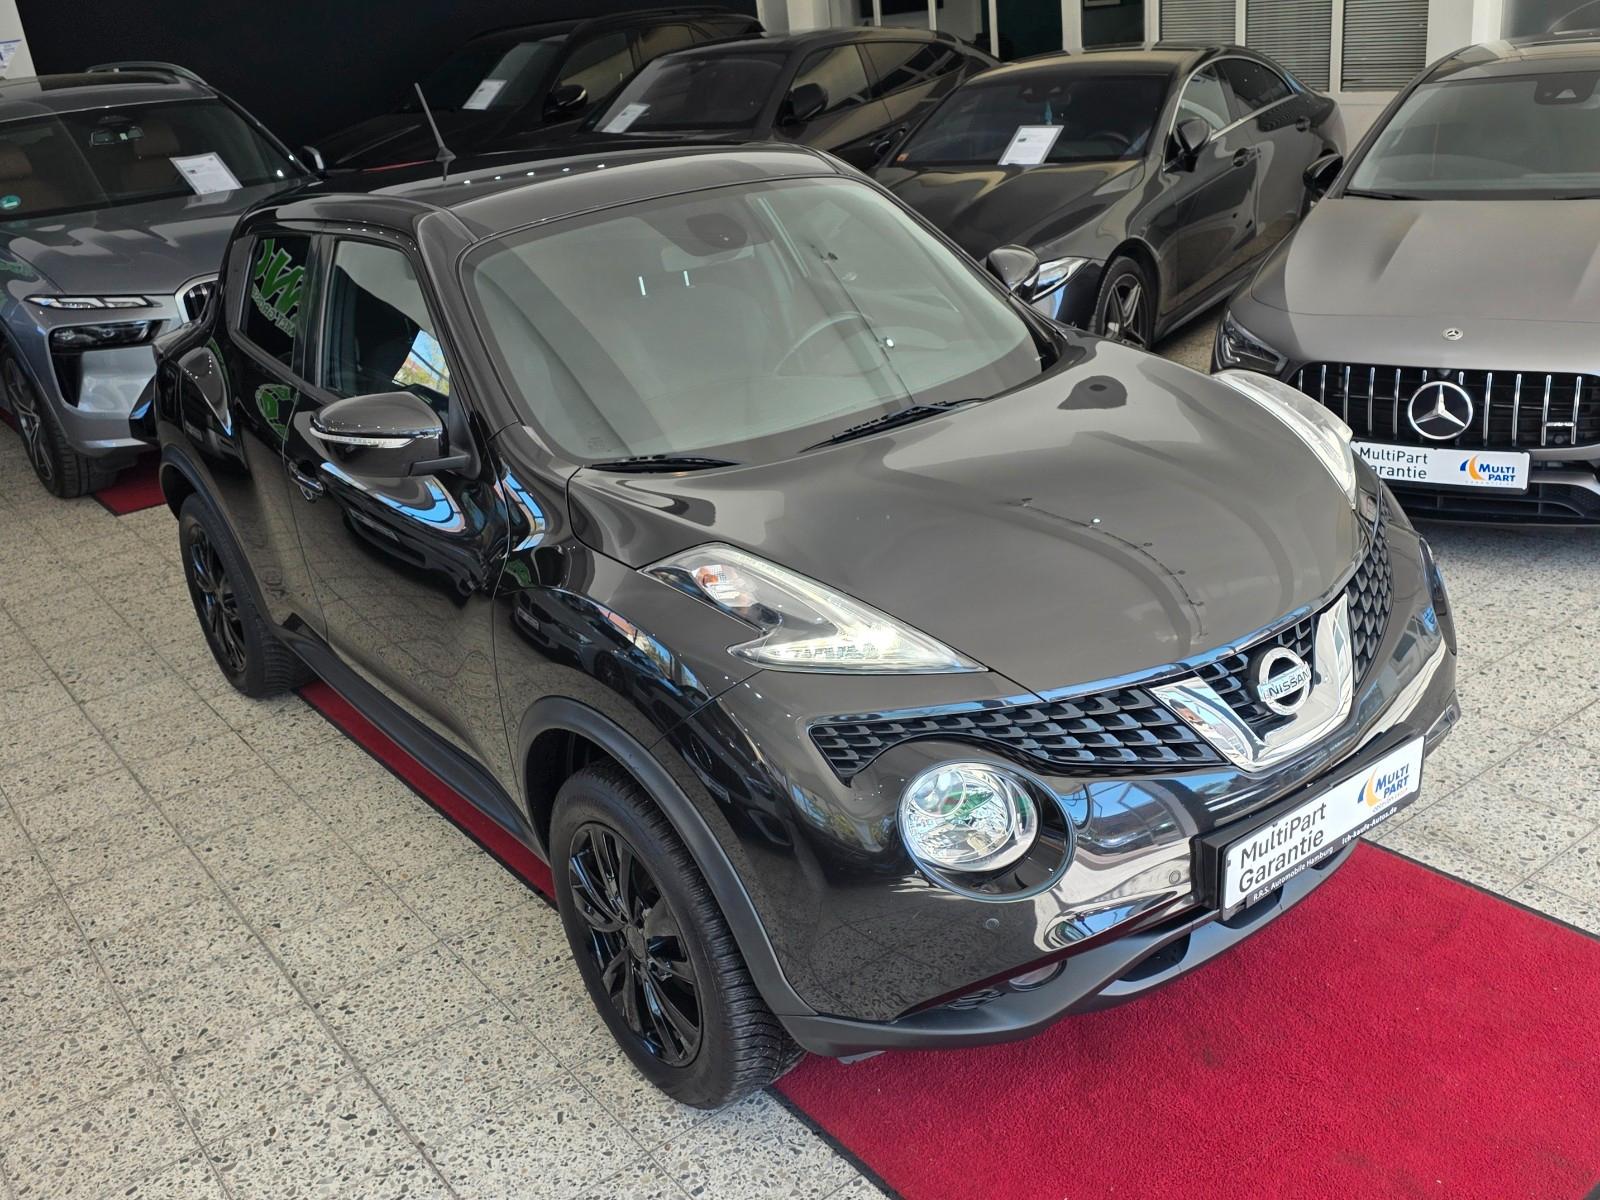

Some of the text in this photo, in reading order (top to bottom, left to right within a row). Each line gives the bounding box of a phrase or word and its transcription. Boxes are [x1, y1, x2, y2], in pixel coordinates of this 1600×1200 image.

[1360, 447, 1428, 464] MultiPart
[1370, 465, 1427, 479] rantie
[1488, 474, 1516, 482] PART
[1268, 668, 1310, 696] NISSAN
[1383, 774, 1409, 799] PART
[1240, 802, 1326, 869] MultiPart
[1239, 830, 1324, 893] Garantie
[1270, 863, 1306, 891] Automobile
[1306, 846, 1334, 868] Hamburg
